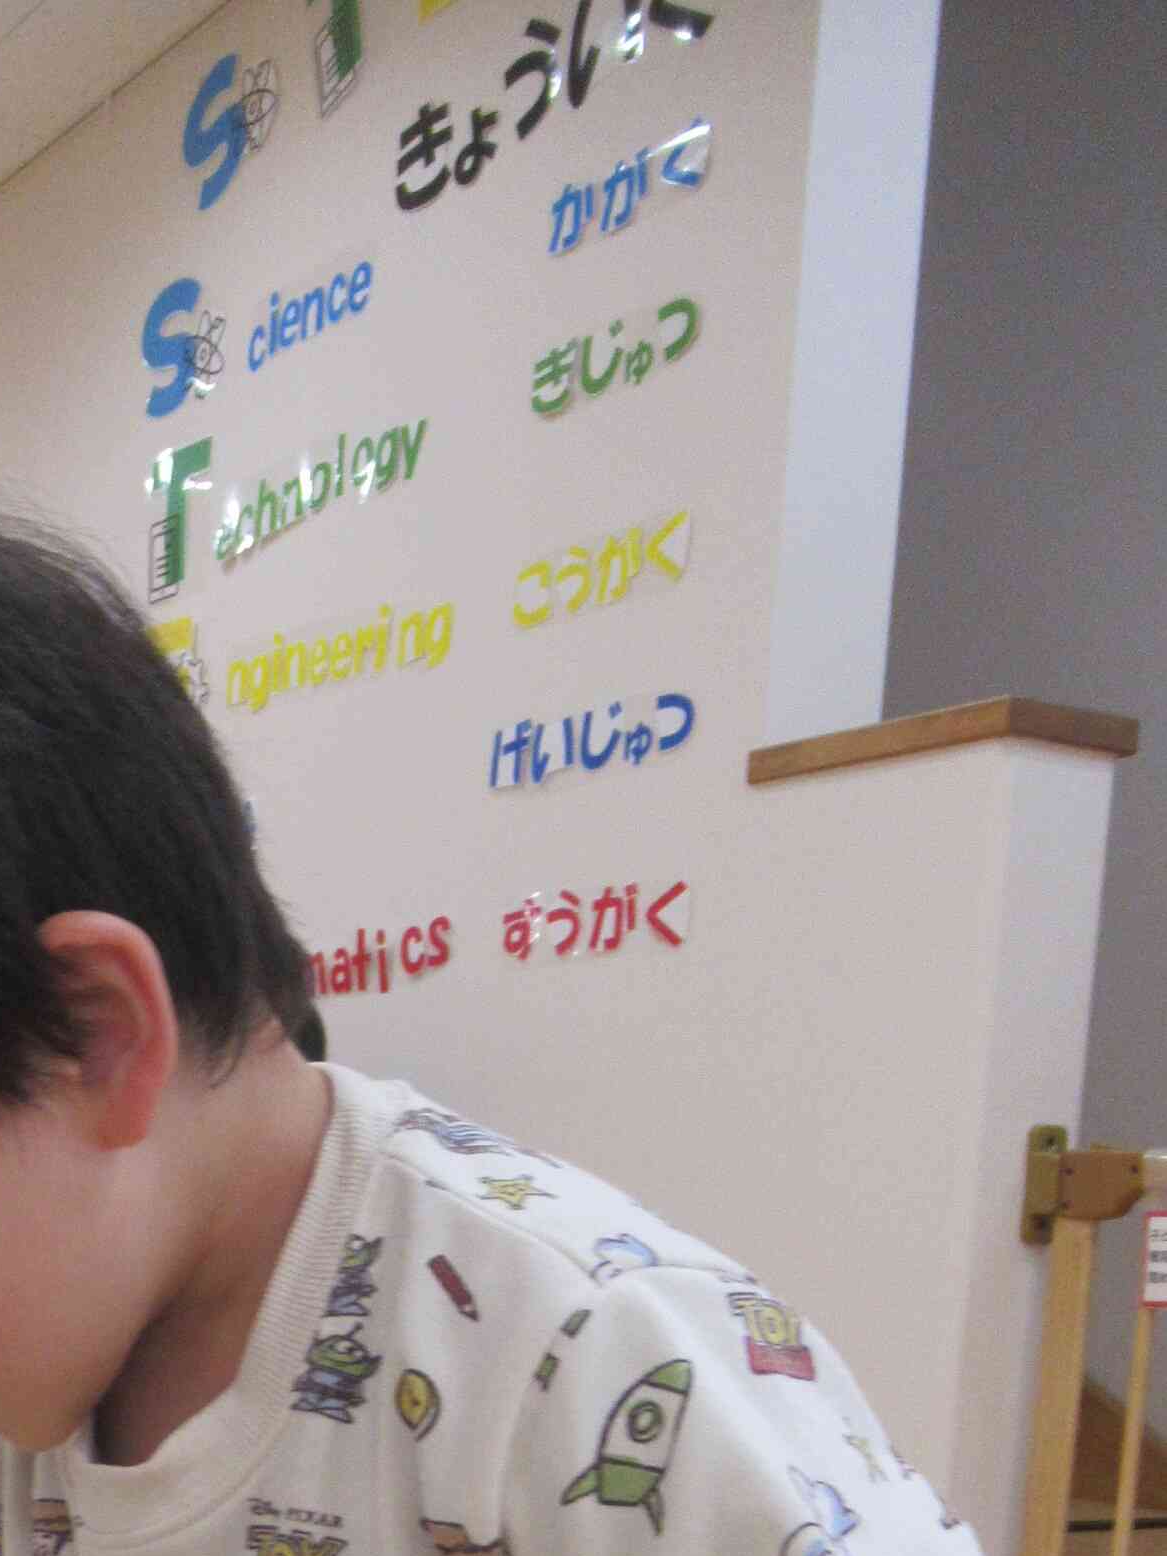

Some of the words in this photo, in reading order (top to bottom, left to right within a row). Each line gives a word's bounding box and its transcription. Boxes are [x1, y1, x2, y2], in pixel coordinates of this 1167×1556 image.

[547, 116, 711, 254] かがく
[532, 298, 701, 412] ぎじゅつ
[514, 510, 688, 628] こうがく
[490, 693, 695, 787] げいじゅつ
